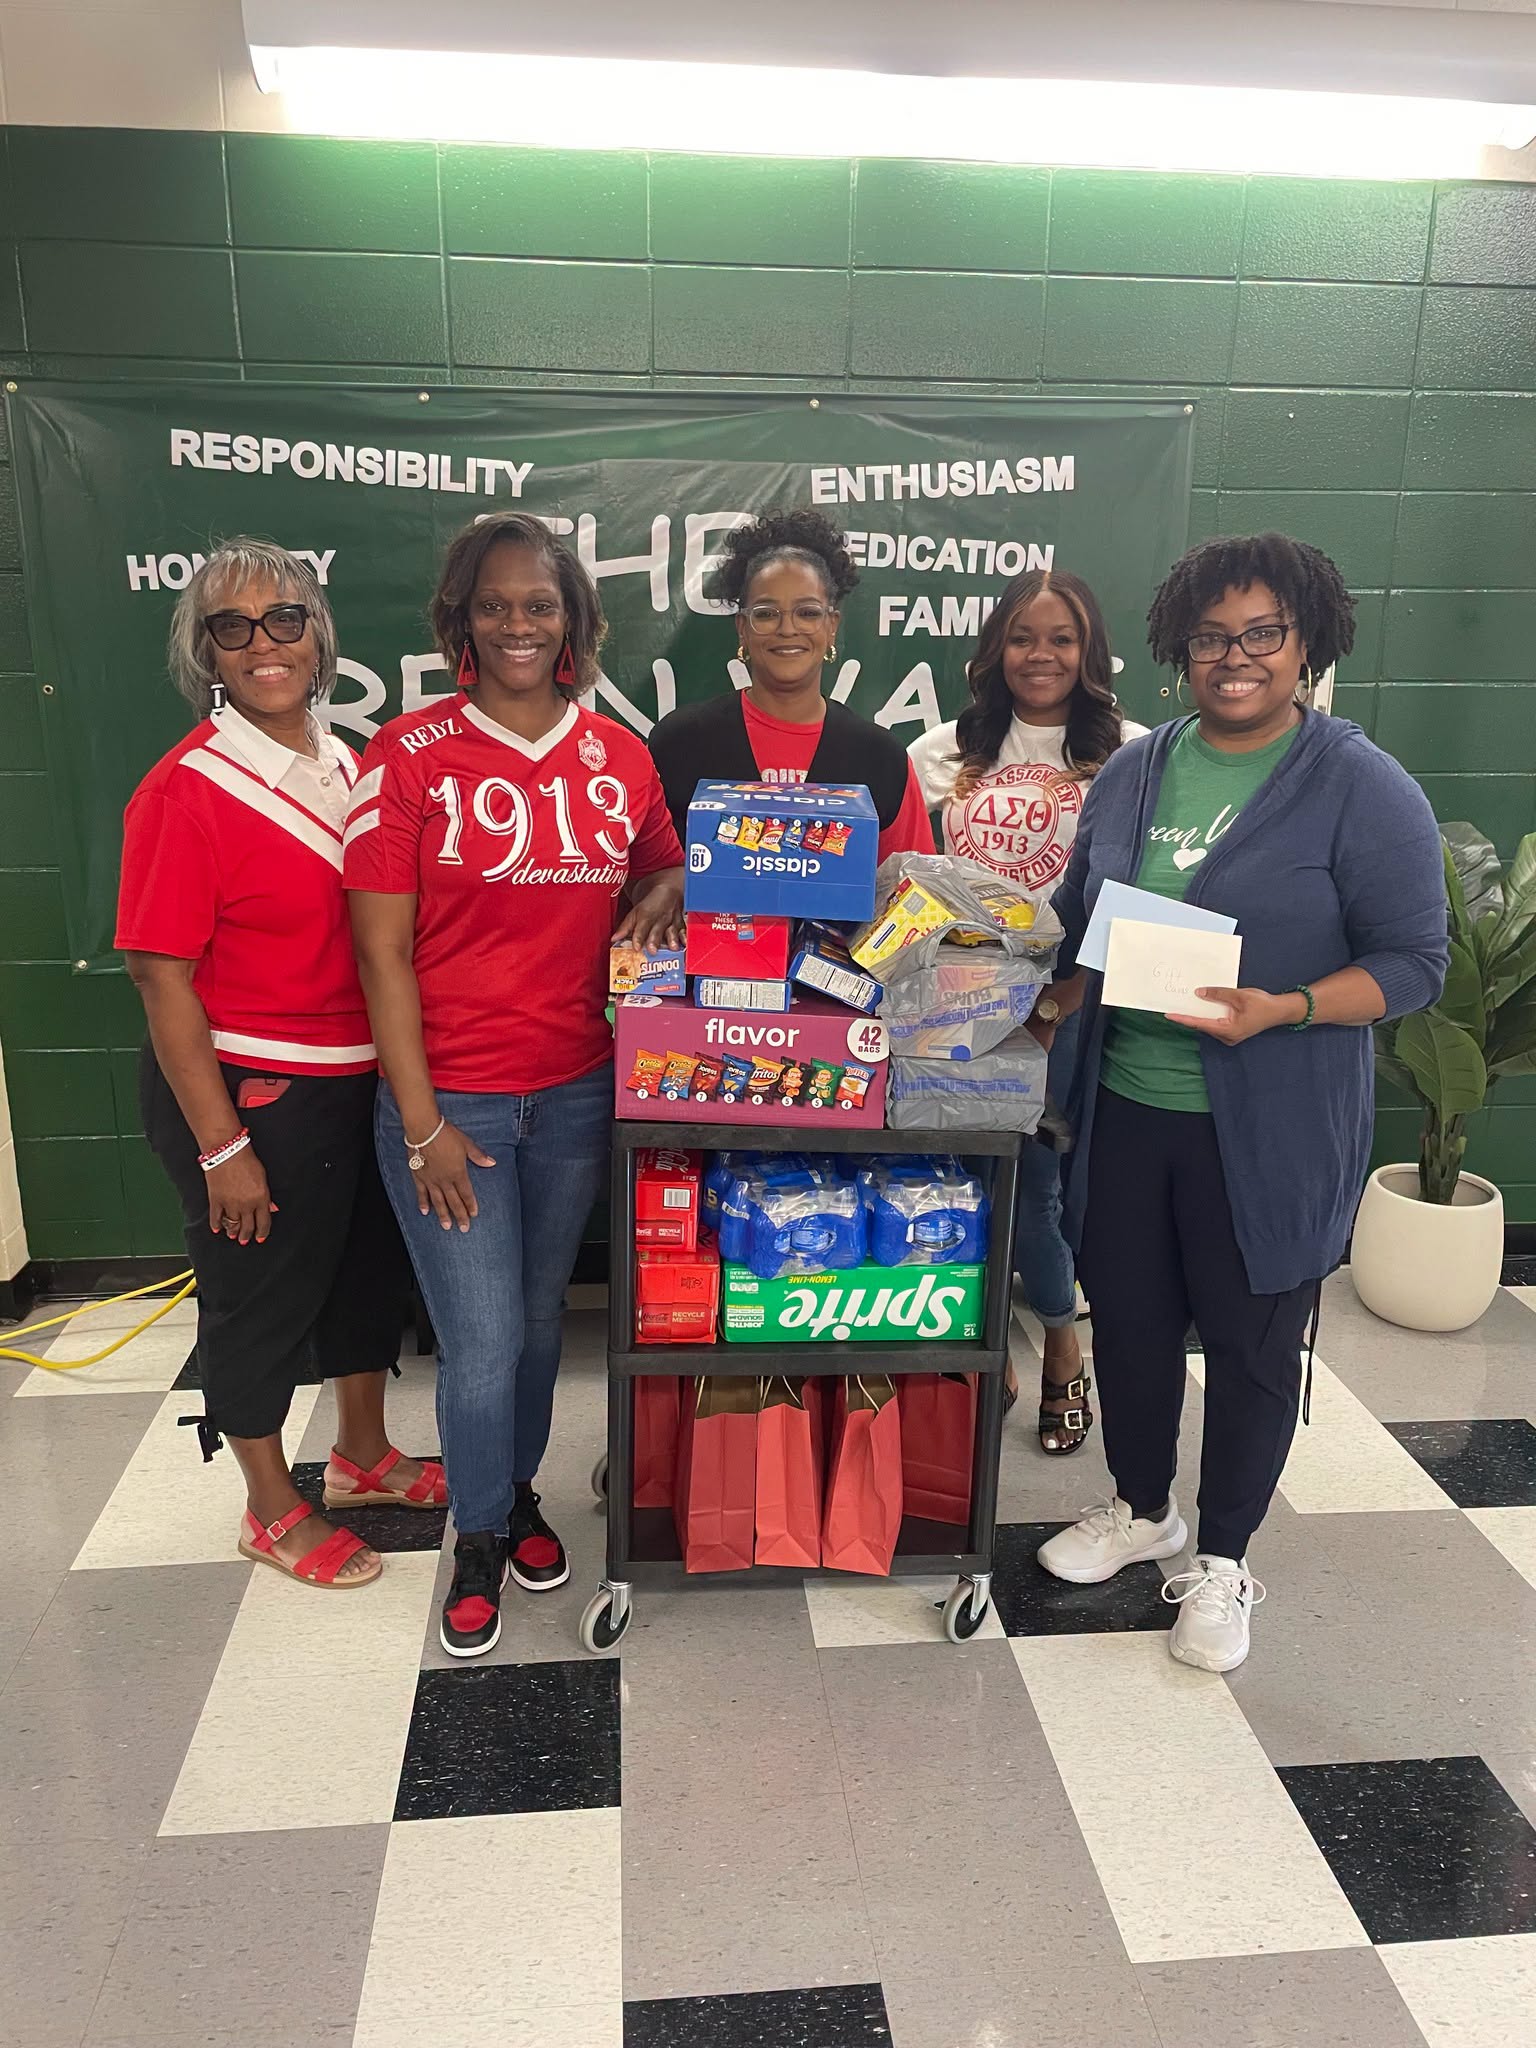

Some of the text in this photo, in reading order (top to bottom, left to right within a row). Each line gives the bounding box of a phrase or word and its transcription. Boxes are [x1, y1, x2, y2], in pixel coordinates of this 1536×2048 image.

[170, 428, 534, 498] RESPONSIBILITY
[811, 455, 1075, 504] ENTHUSIASM
[843, 531, 1055, 577] EDICATION
[879, 596, 1001, 637] FAMI
[398, 718, 463, 755] REDZ
[995, 768, 1077, 815] ASSIGNENT
[428, 775, 637, 883] 1913
[980, 830, 1028, 855] 1913
[691, 854, 706, 867] 18
[742, 855, 821, 878] classic
[511, 858, 629, 898] devastating
[711, 923, 736, 931] PACKS
[640, 959, 680, 975] DONUTS
[704, 1018, 800, 1048] flavor
[858, 1026, 882, 1046] 42
[788, 1275, 837, 1284] LEMON-LIME
[778, 1274, 966, 1341] Sprite
[964, 1327, 976, 1337] 12
